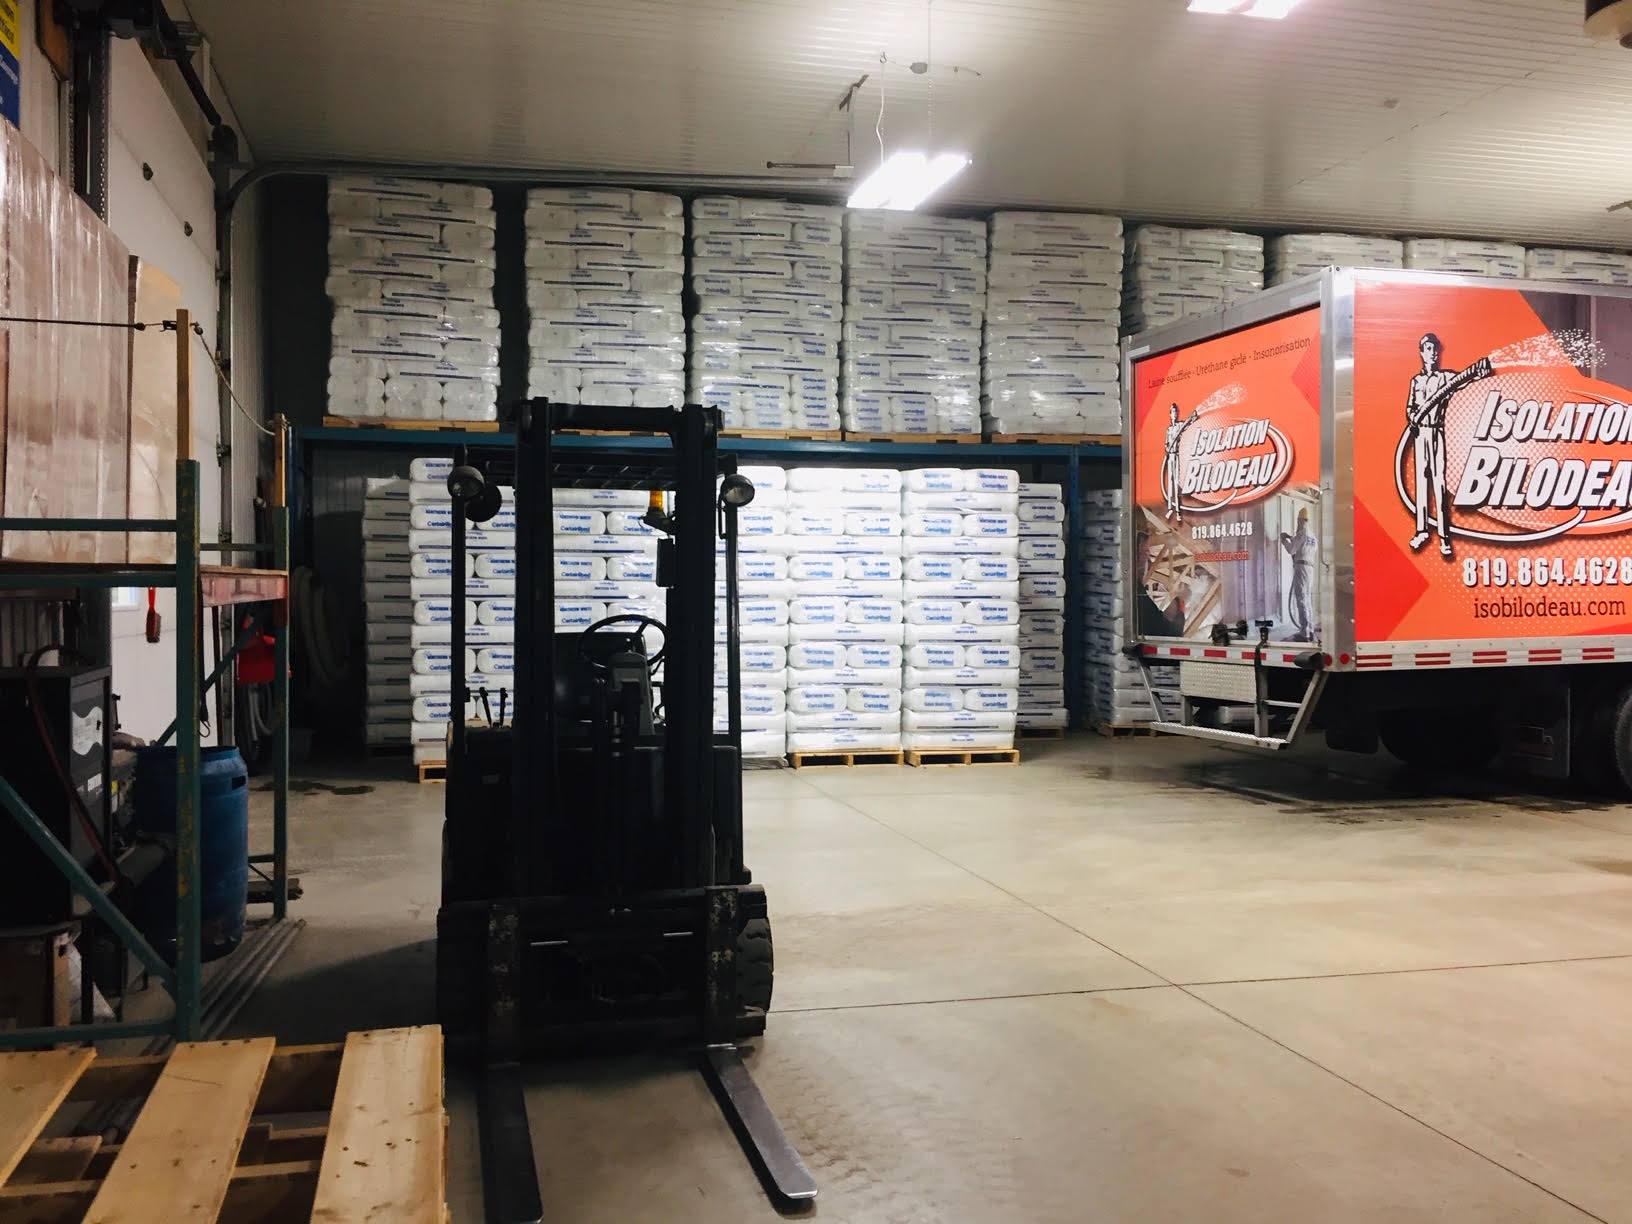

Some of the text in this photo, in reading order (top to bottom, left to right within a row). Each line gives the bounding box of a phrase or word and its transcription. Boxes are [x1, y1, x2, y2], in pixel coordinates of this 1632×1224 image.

[1253, 336, 1312, 361] Insonorisation
[1452, 445, 1632, 510] BILODEA
[1191, 521, 1253, 540] 819.864.4628
[1474, 595, 1626, 619] isobilodeau.com
